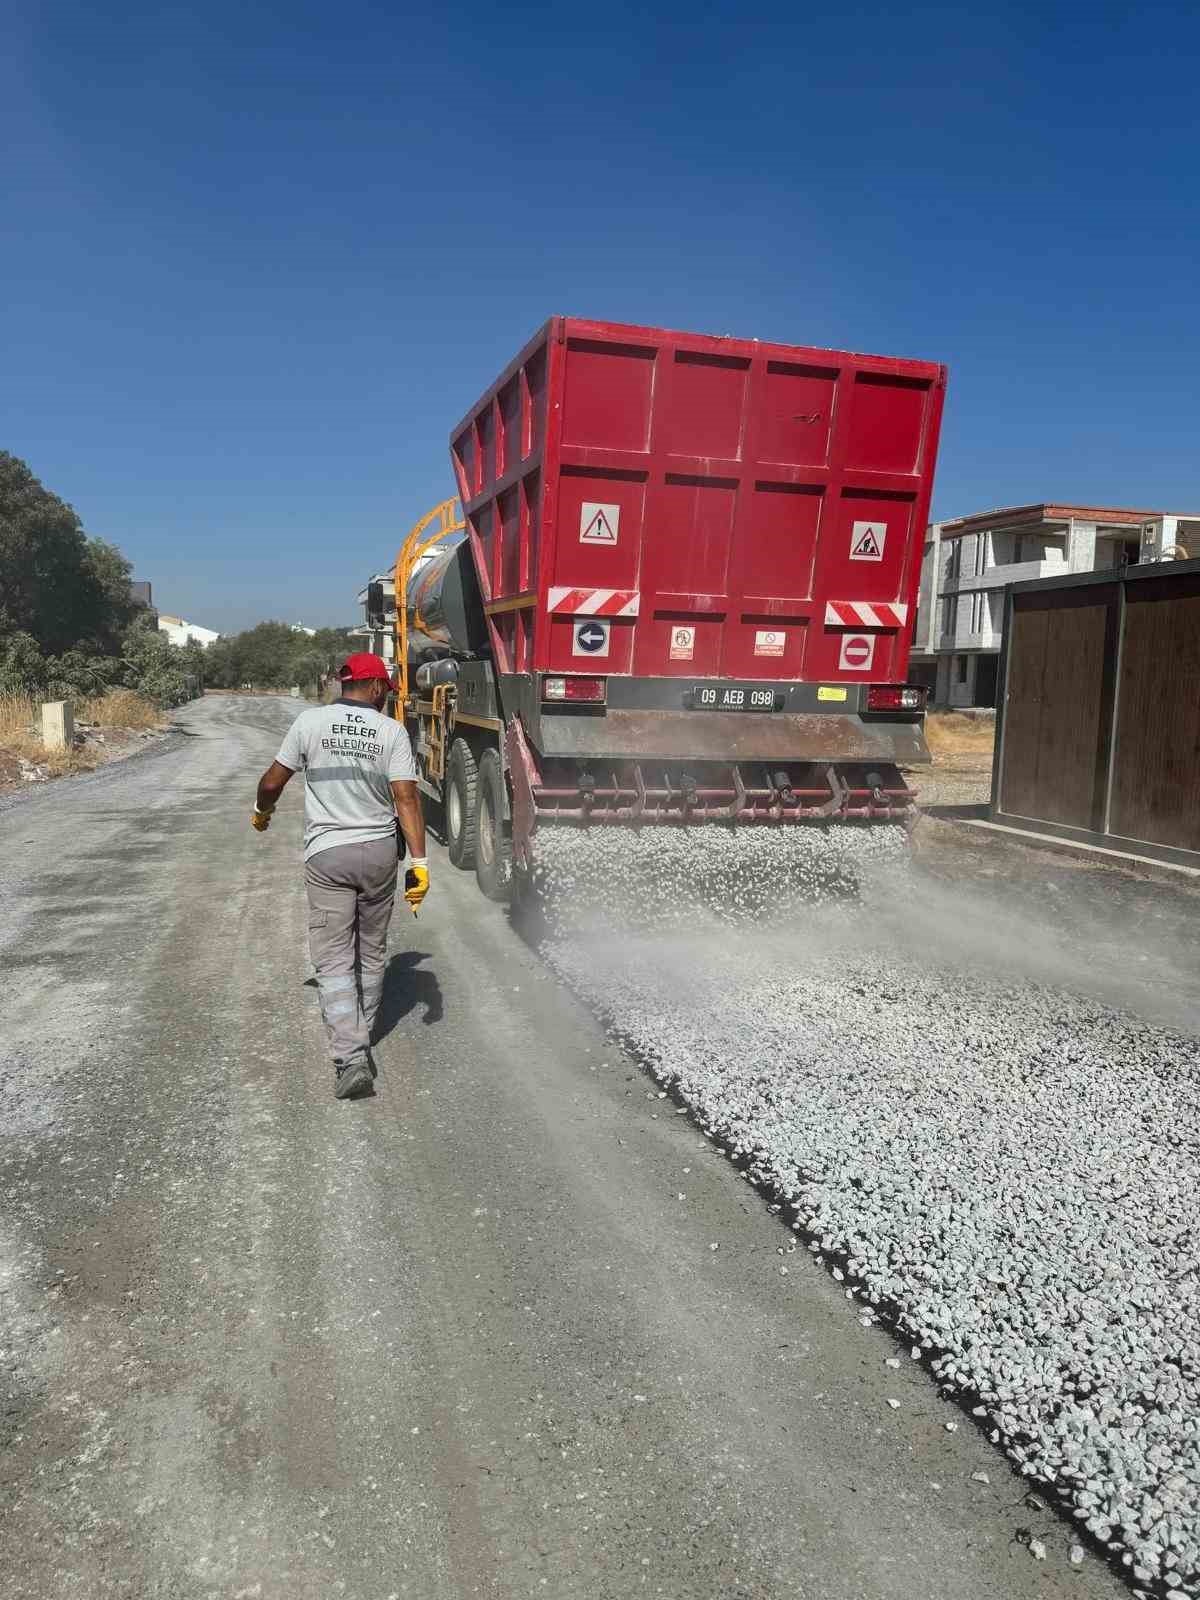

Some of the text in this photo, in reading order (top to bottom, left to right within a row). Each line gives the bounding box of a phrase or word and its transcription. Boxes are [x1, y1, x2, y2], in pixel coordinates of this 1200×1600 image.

[702, 689, 772, 705] 09 AEB 098
[345, 713, 366, 724] T.C.
[332, 724, 377, 738] EFELER
